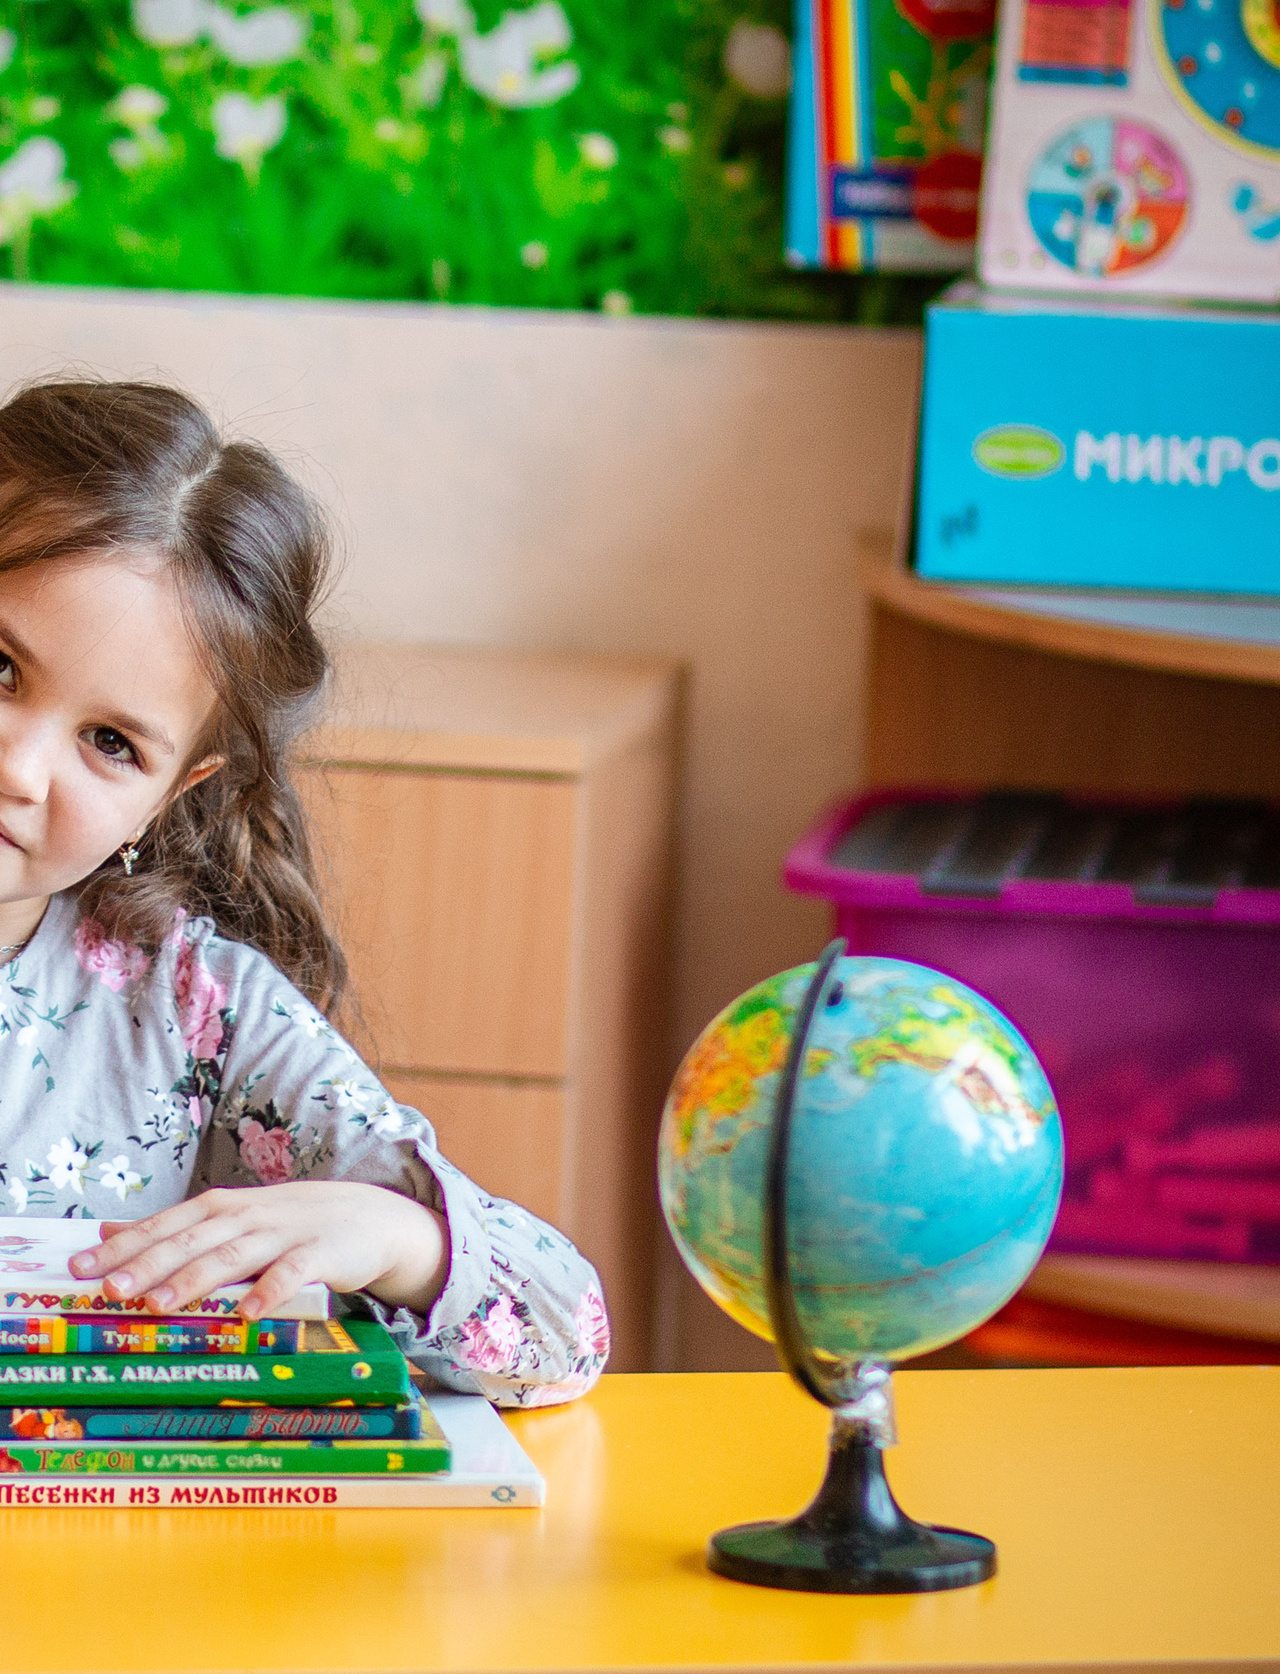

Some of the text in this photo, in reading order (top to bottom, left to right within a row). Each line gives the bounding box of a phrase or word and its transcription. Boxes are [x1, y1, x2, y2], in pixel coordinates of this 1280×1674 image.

[102, 1331, 140, 1348] Тук
[154, 1334, 191, 1348] тук
[205, 1334, 240, 1348] тук
[71, 1365, 116, 1383] Г.Х.
[121, 1363, 260, 1383] АНДЕРСЕНА
